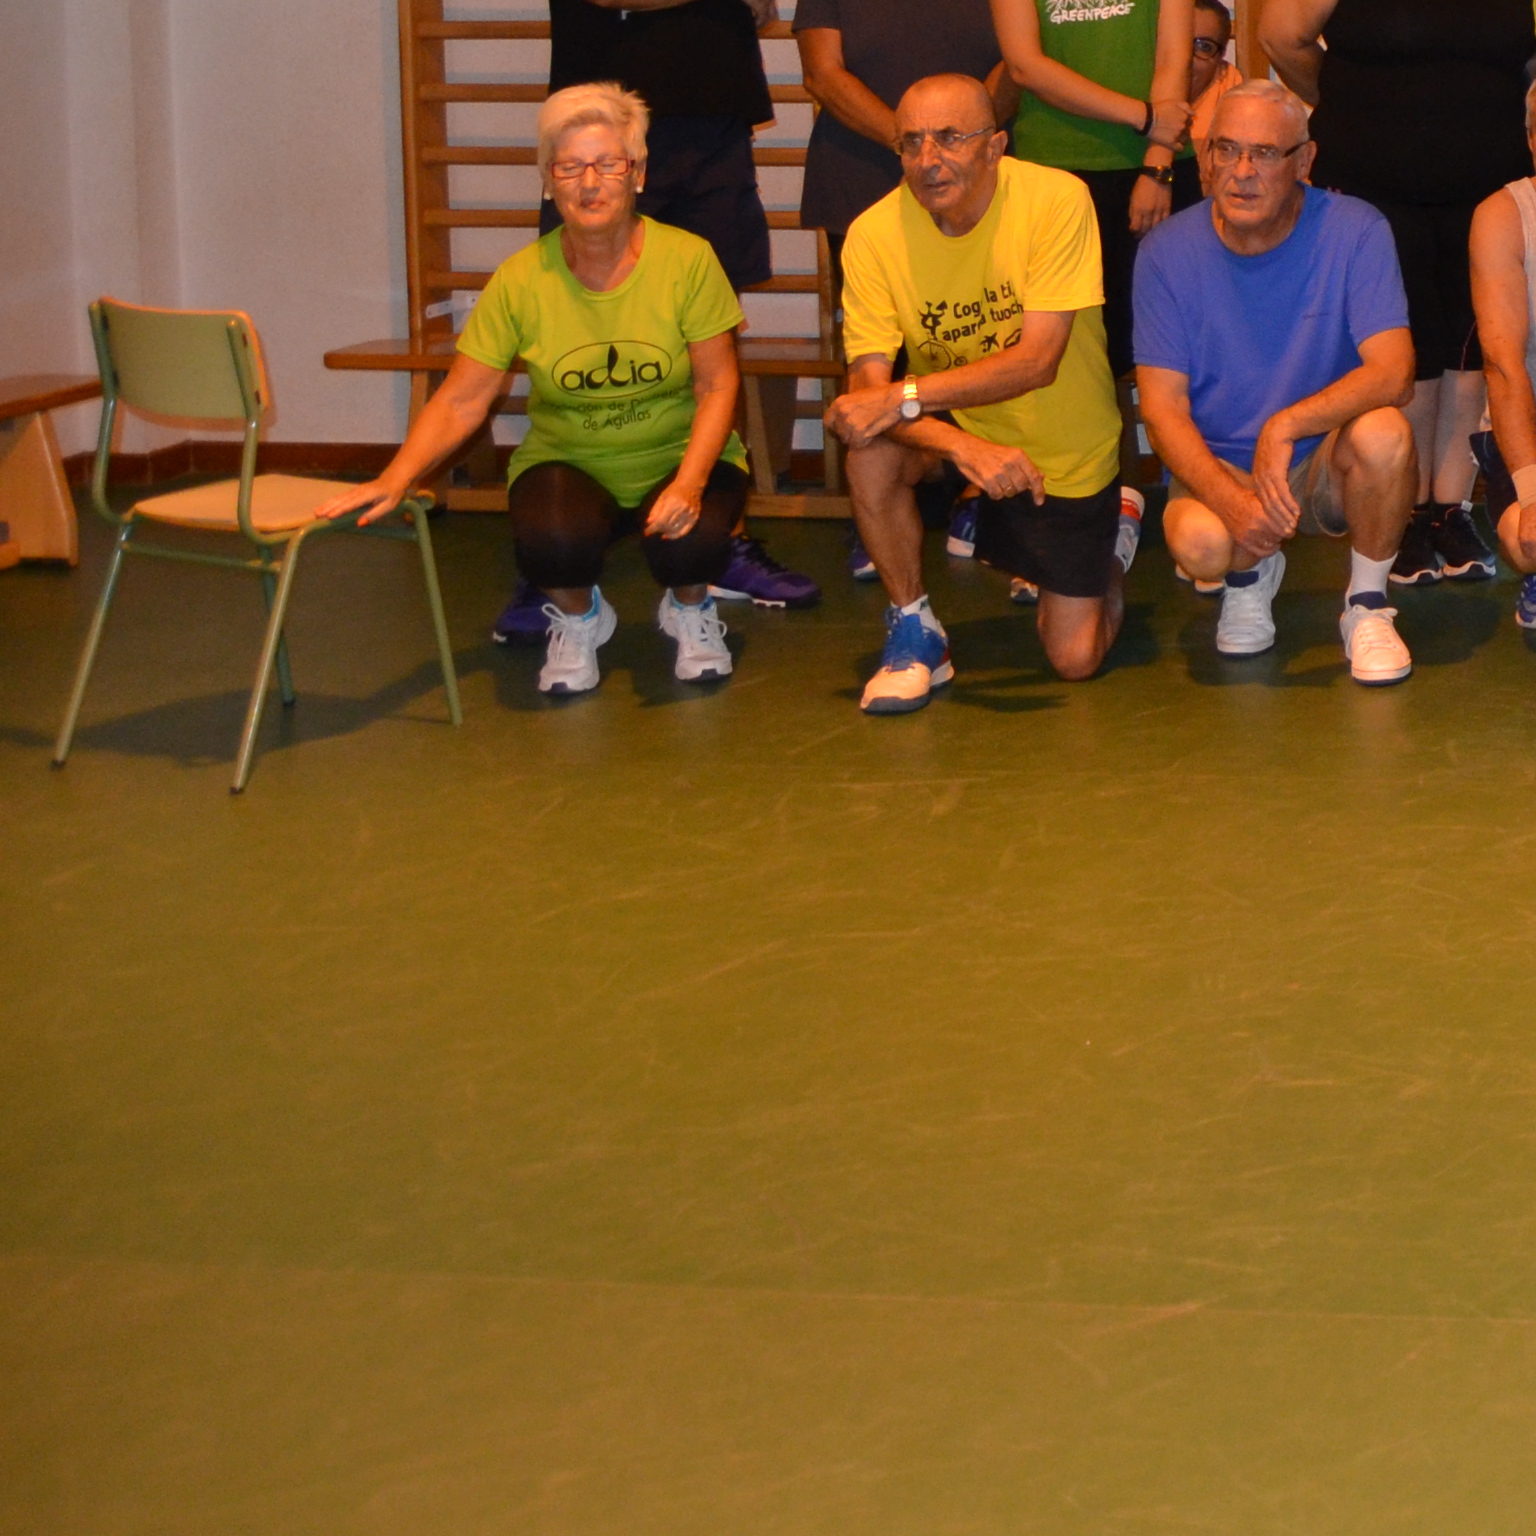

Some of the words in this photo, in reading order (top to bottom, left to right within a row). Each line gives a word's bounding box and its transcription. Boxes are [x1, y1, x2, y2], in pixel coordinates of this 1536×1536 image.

[1050, 2, 1135, 24] GREENPEACE
[984, 287, 998, 303] la
[561, 345, 663, 391] adia
[583, 416, 598, 430] de
